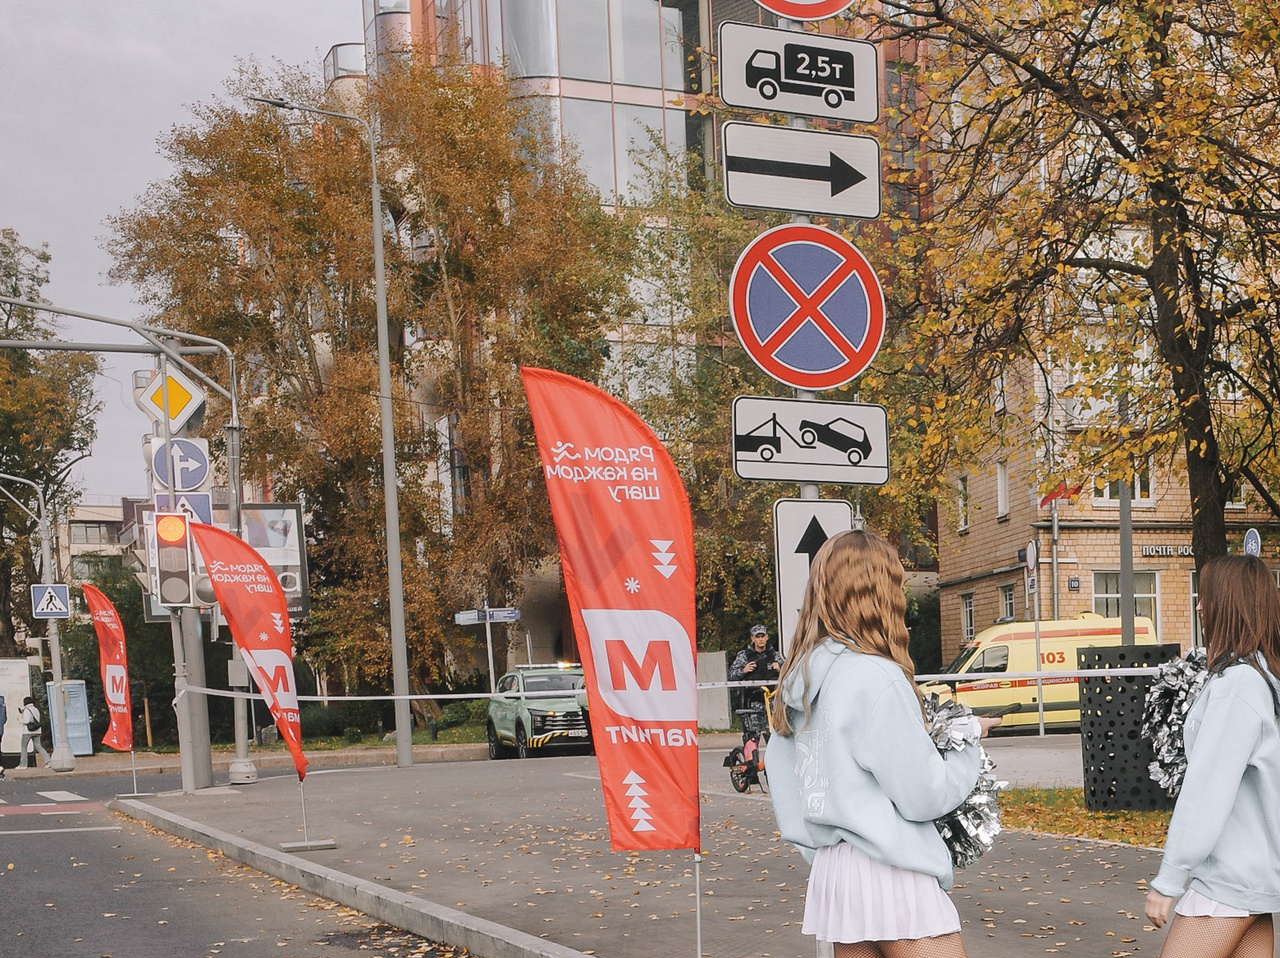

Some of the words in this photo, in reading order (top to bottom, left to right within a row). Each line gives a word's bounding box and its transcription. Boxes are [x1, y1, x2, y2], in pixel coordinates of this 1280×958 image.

[796, 53, 844, 79] 2,5т
[1142, 545, 1174, 556] ПОЧТА
[1177, 545, 1195, 556] РОС
[1040, 652, 1066, 665] 103
